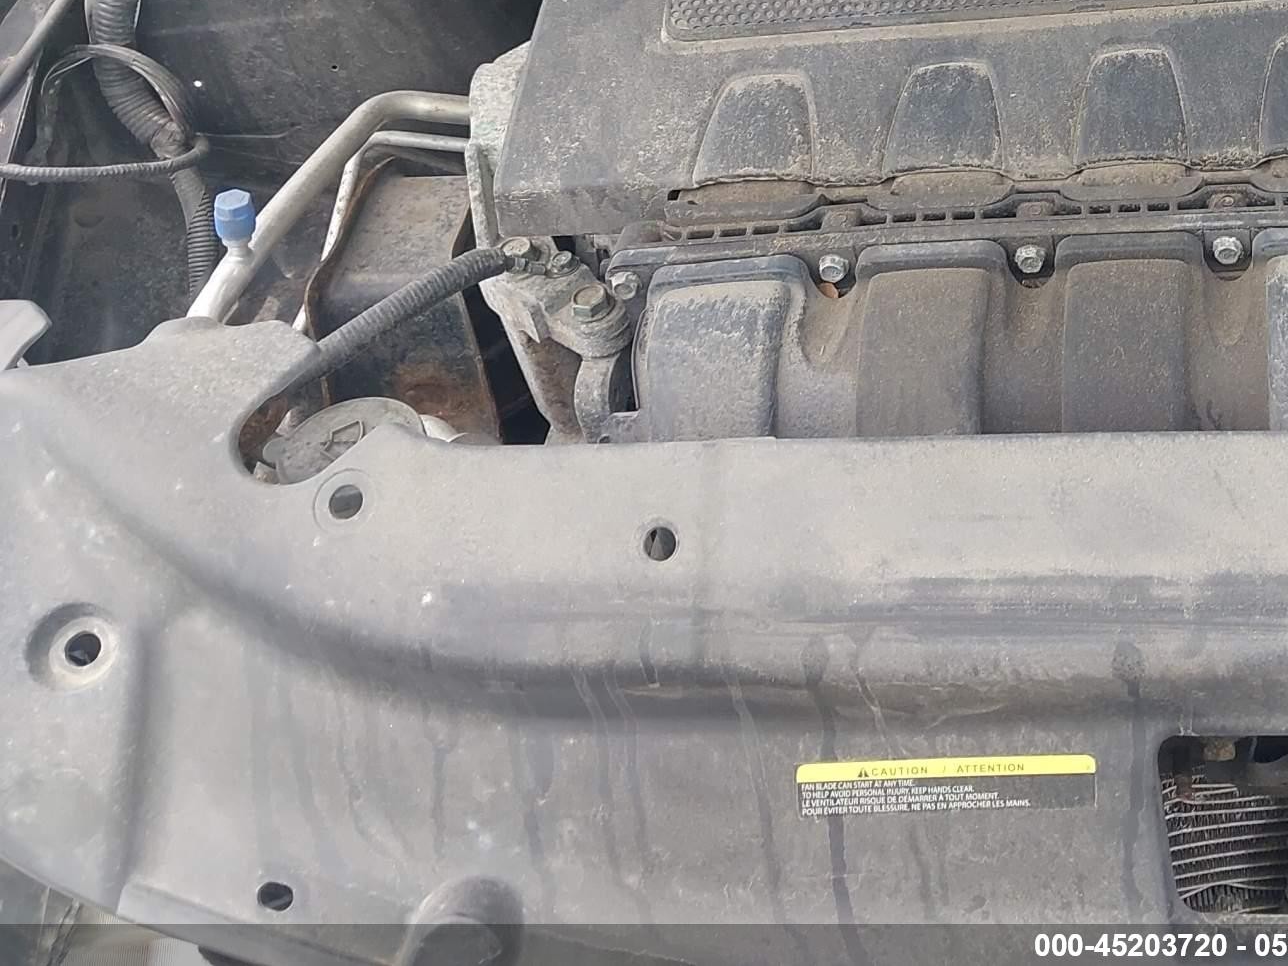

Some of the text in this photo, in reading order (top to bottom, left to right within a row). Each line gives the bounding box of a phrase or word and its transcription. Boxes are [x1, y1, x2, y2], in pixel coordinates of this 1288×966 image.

[871, 766, 928, 777] CAUTION
[956, 763, 1025, 773] ATTENTION
[812, 790, 829, 798] HELP
[831, 789, 851, 797] AVOID
[852, 788, 885, 796] PERSONAL
[928, 785, 951, 793] HANDS
[815, 782, 837, 790] BLADE
[854, 780, 873, 789] START
[811, 797, 858, 807] VENTILATEUR
[945, 793, 964, 801] TOUT
[849, 805, 872, 813] TOUTE
[922, 802, 936, 810] PAS
[948, 800, 991, 809] APPROCHER
[991, 800, 1005, 808] LES
